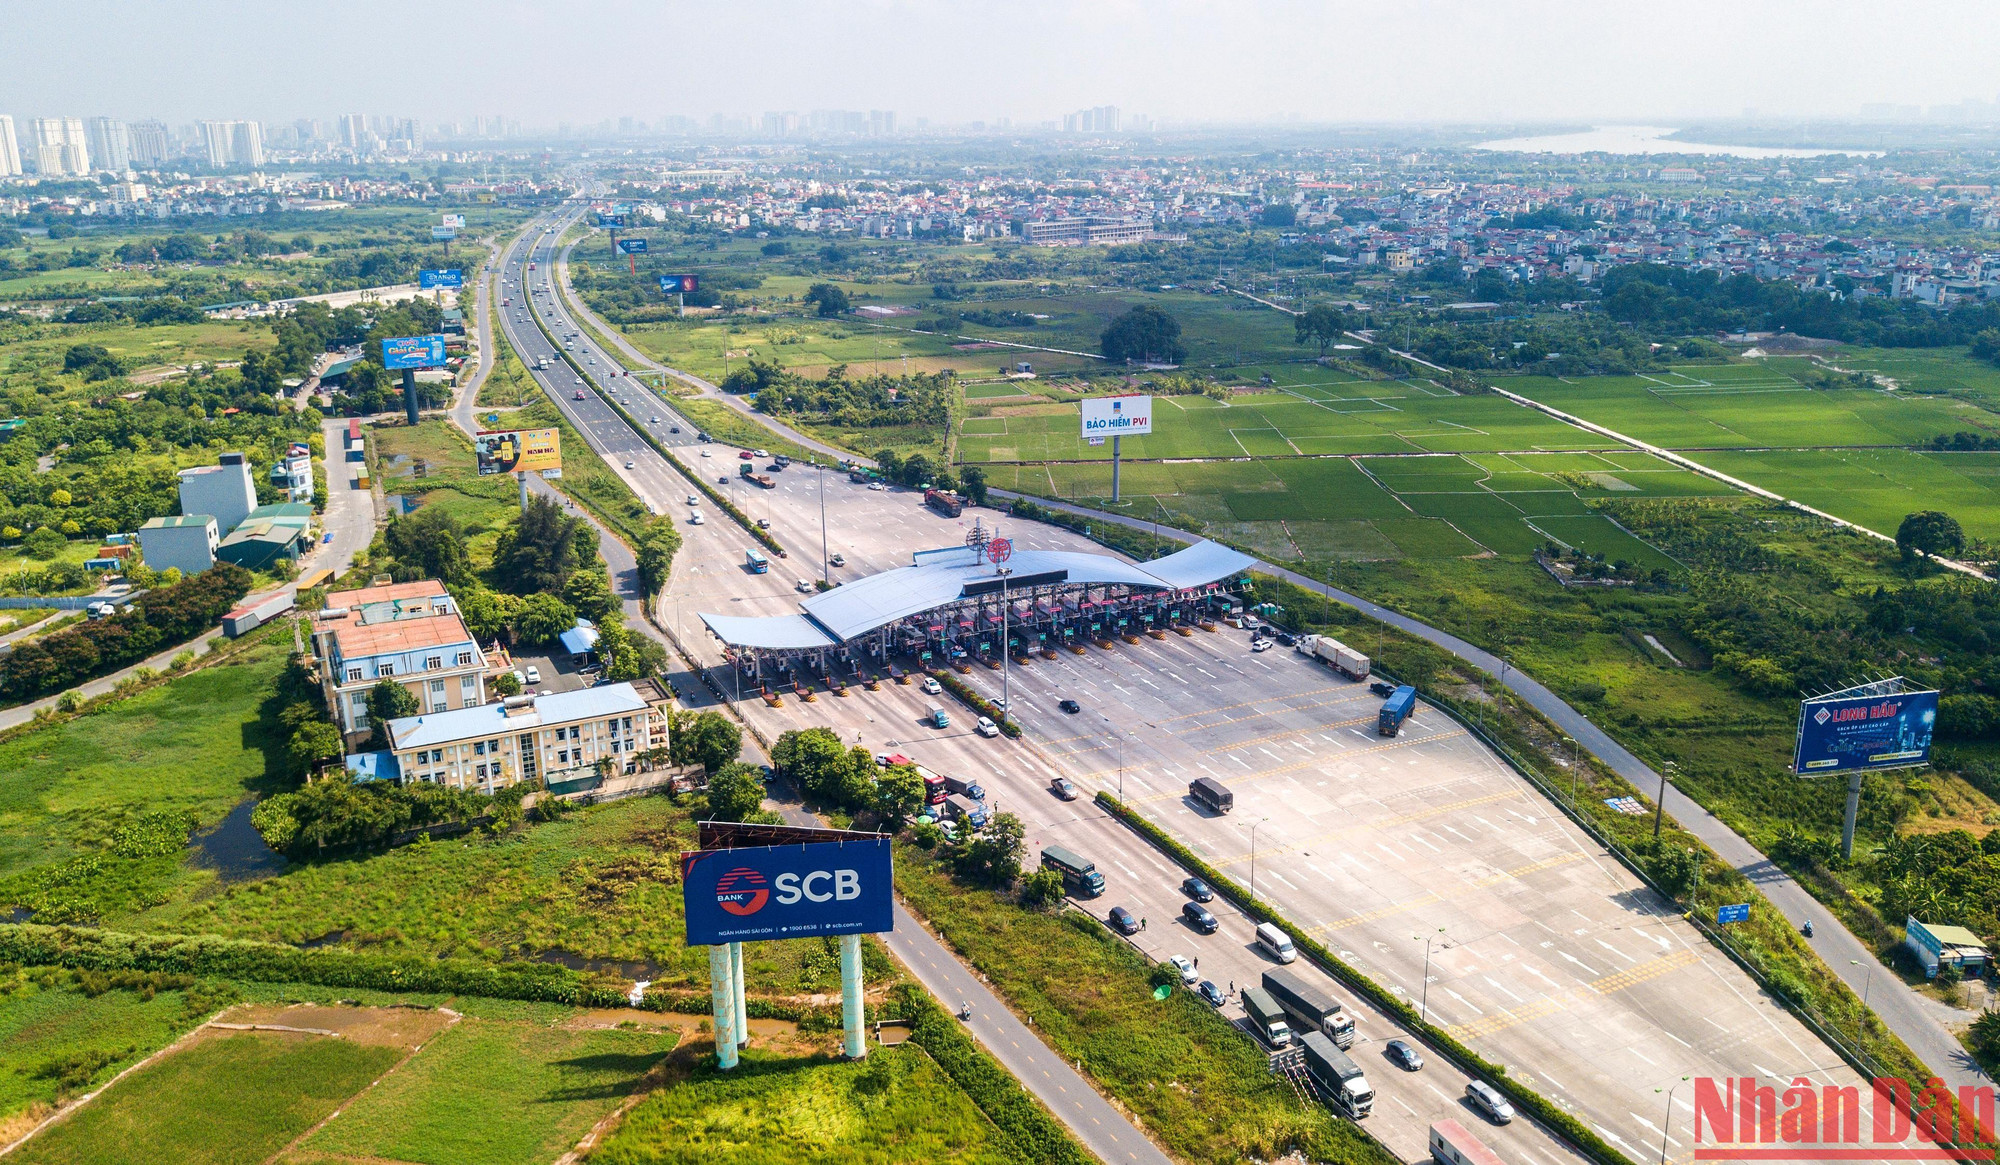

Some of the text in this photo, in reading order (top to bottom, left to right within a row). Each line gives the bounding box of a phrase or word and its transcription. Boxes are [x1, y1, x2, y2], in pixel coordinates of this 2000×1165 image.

[1086, 414, 1147, 429] BẢO HIỂM PVI
[1832, 708, 1867, 722] LONG
[775, 869, 861, 904] SCB
[717, 894, 743, 902] BANK
